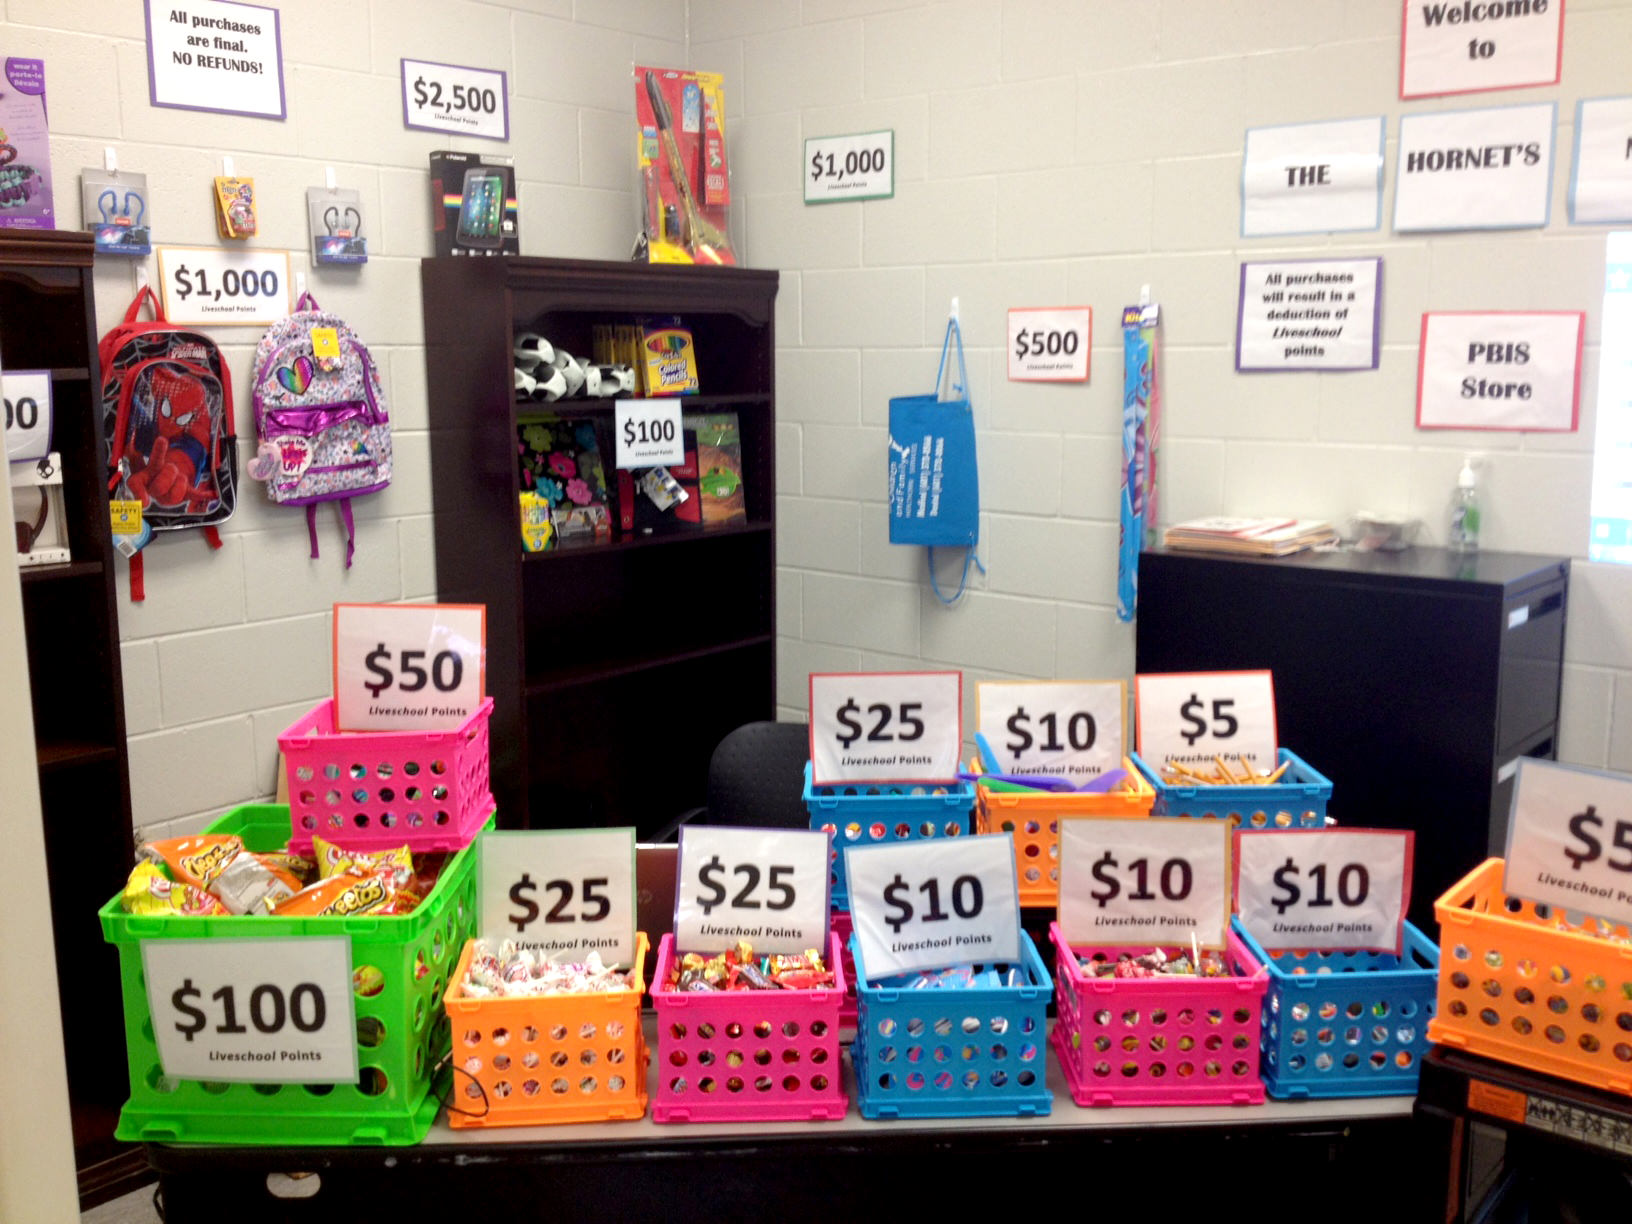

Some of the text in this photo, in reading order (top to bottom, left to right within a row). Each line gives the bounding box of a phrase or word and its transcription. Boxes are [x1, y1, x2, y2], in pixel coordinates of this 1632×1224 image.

[169, 9, 262, 37] All purchases
[1423, 0, 1549, 28] Welcome
[187, 34, 248, 53] are final.
[1468, 37, 1496, 60] to
[172, 51, 263, 75] NO REFUNDS!
[413, 76, 496, 115] $2,500
[811, 147, 886, 182] $1,000
[1406, 143, 1541, 174] HORNET'S
[1285, 164, 1331, 188] THE
[174, 264, 279, 303] $1,000
[1265, 271, 1354, 286] All purchases
[1262, 290, 1356, 304] will result in a
[1266, 308, 1348, 321] deduction of
[1015, 328, 1079, 361] $500
[1272, 326, 1342, 339] Liveschool
[1284, 344, 1325, 359] points
[1467, 341, 1531, 365] PBIS
[1461, 376, 1533, 400] Store
[624, 418, 675, 448] $100
[364, 644, 464, 698] $50
[369, 706, 467, 717] Liveschool Points
[835, 697, 925, 749] $25
[1178, 693, 1239, 747] $5
[1005, 707, 1096, 759] $10
[841, 754, 932, 766] Liveschool Points
[1011, 763, 1101, 775] Liveschool Points
[1164, 752, 1219, 763] Liveschool
[697, 856, 796, 915] $25
[1090, 851, 1193, 908] $10
[1271, 857, 1370, 915] $10
[1537, 872, 1614, 899] Liveschool
[508, 873, 611, 932] $25
[882, 873, 984, 934] $10
[700, 926, 802, 939] Liveschool Points
[1095, 916, 1197, 927] Liveschool Points
[1272, 922, 1373, 933] Liveschool Points
[515, 937, 619, 952] Liveschool Points
[892, 933, 992, 953] Liveschool Points
[171, 978, 327, 1042] $100
[209, 1050, 322, 1062] Liveschool Points
